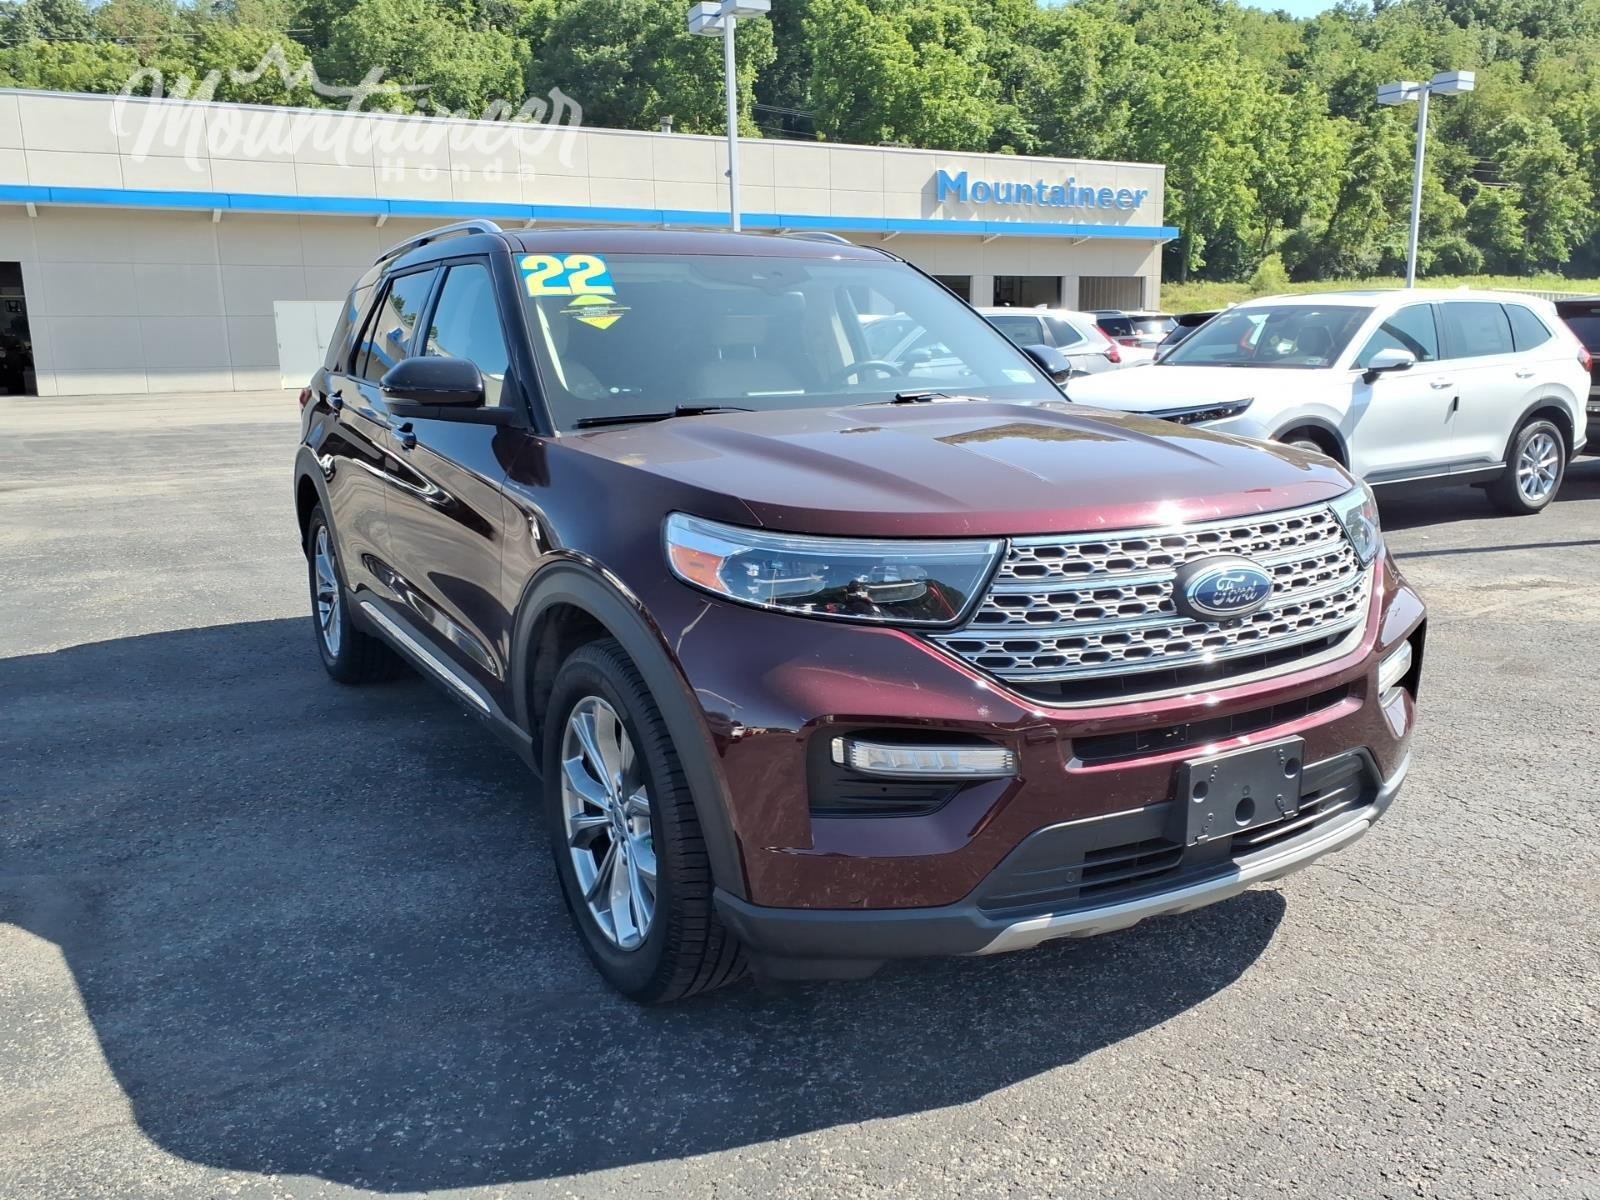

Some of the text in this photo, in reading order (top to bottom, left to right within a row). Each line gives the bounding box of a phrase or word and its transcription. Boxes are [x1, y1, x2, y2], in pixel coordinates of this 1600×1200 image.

[936, 168, 1149, 211] Mountaineer
[520, 254, 617, 297] 22
[1212, 575, 1258, 606] Ford
